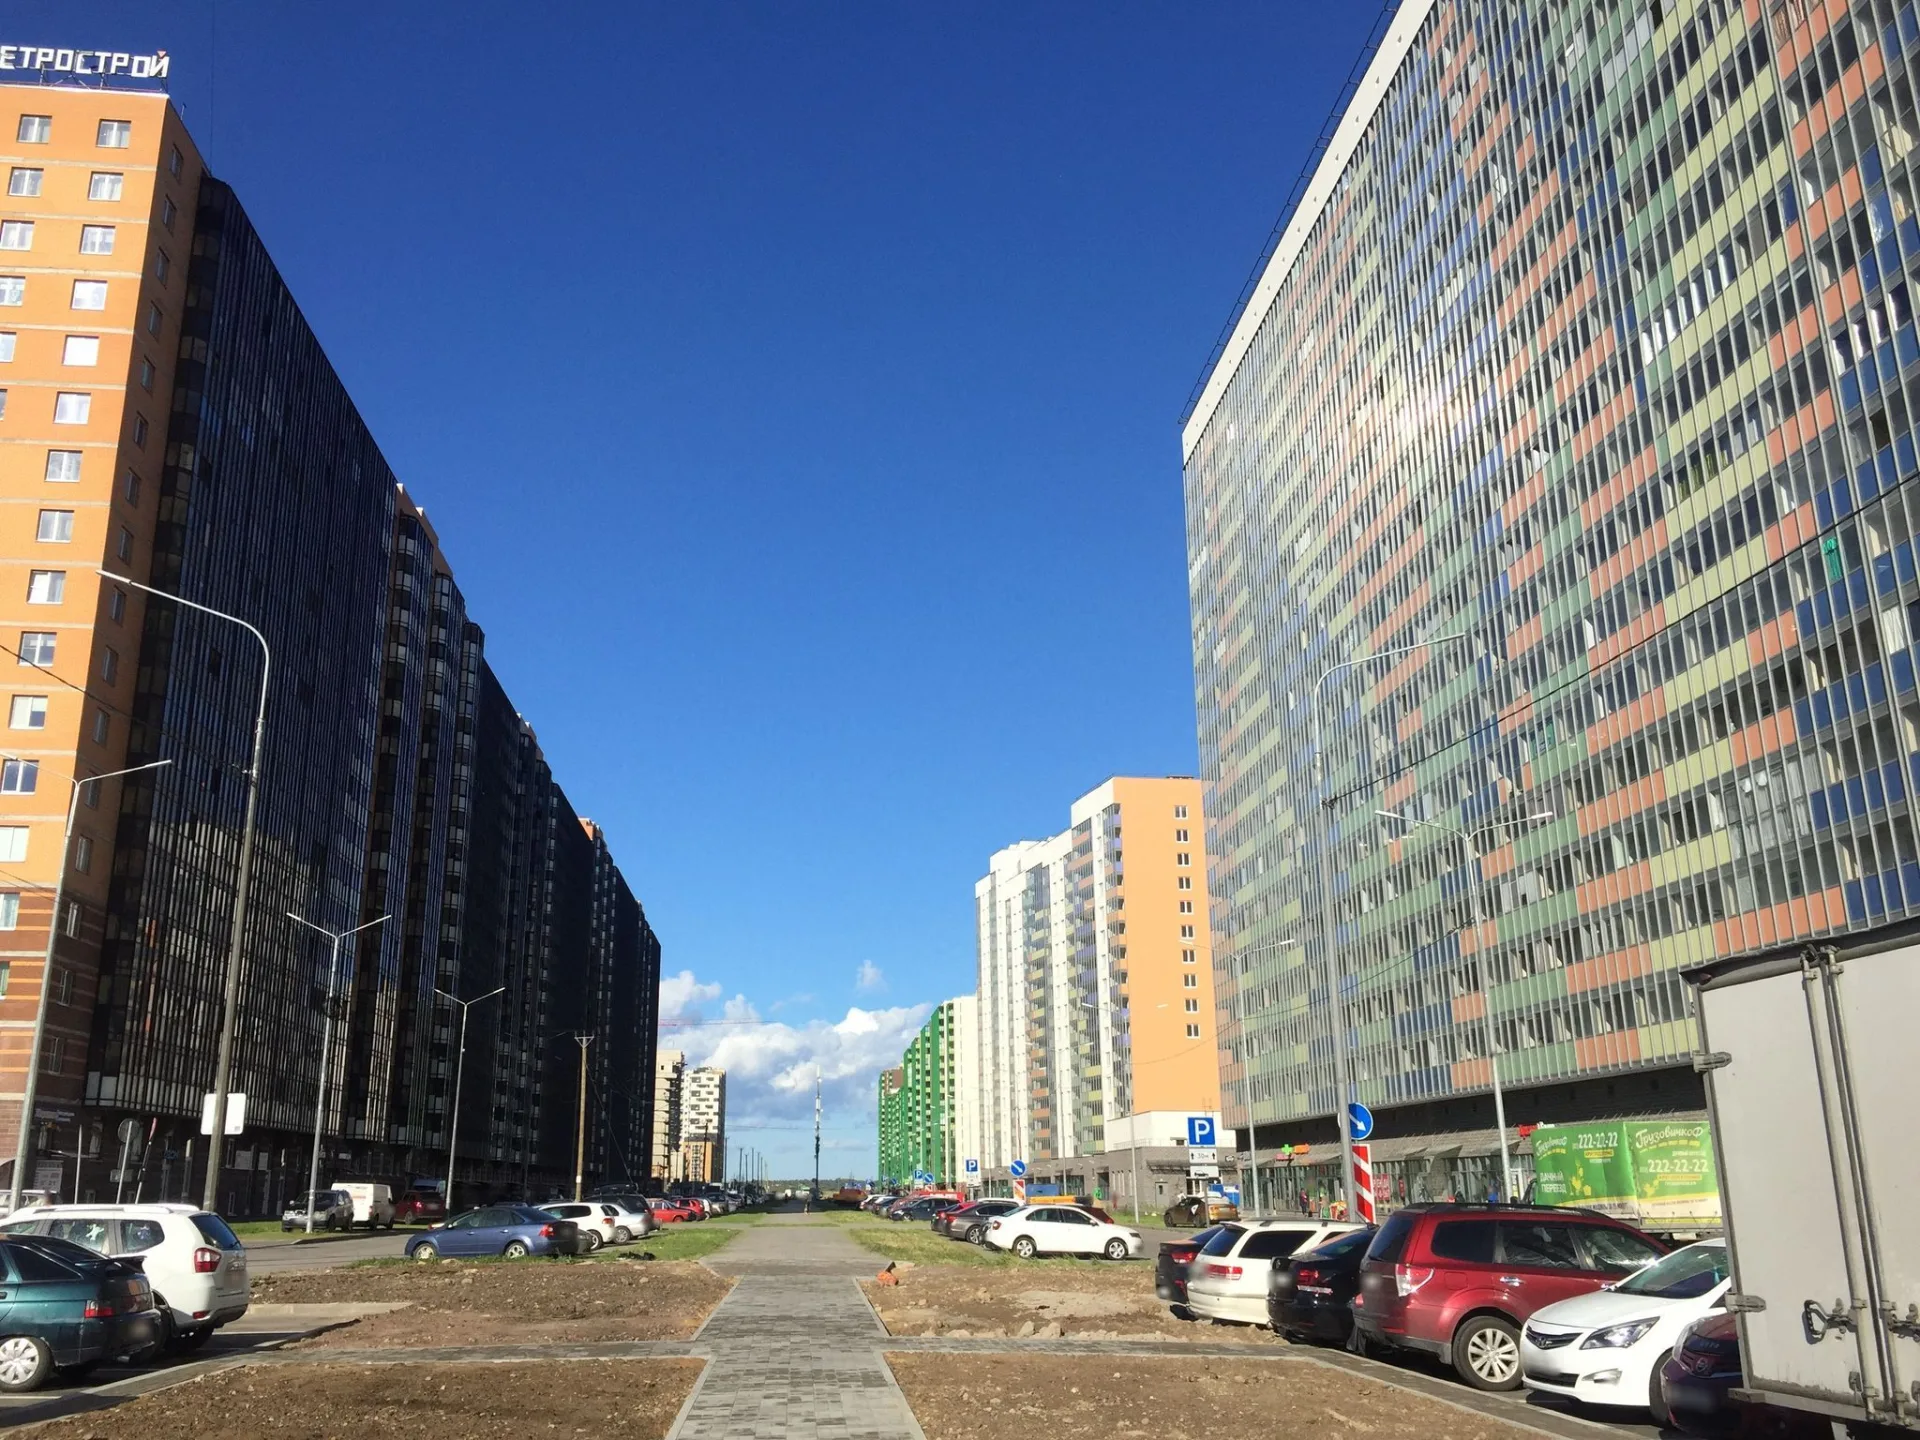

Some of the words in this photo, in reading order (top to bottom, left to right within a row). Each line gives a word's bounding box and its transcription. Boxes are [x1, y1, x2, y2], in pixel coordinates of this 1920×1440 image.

[1194, 1119, 1211, 1143] P
[1635, 1125, 1704, 1149] ГрузовичкоФ
[1578, 1132, 1618, 1149] 222-22-22
[968, 1160, 977, 1171] P
[1647, 1159, 1710, 1173] 222-22-22
